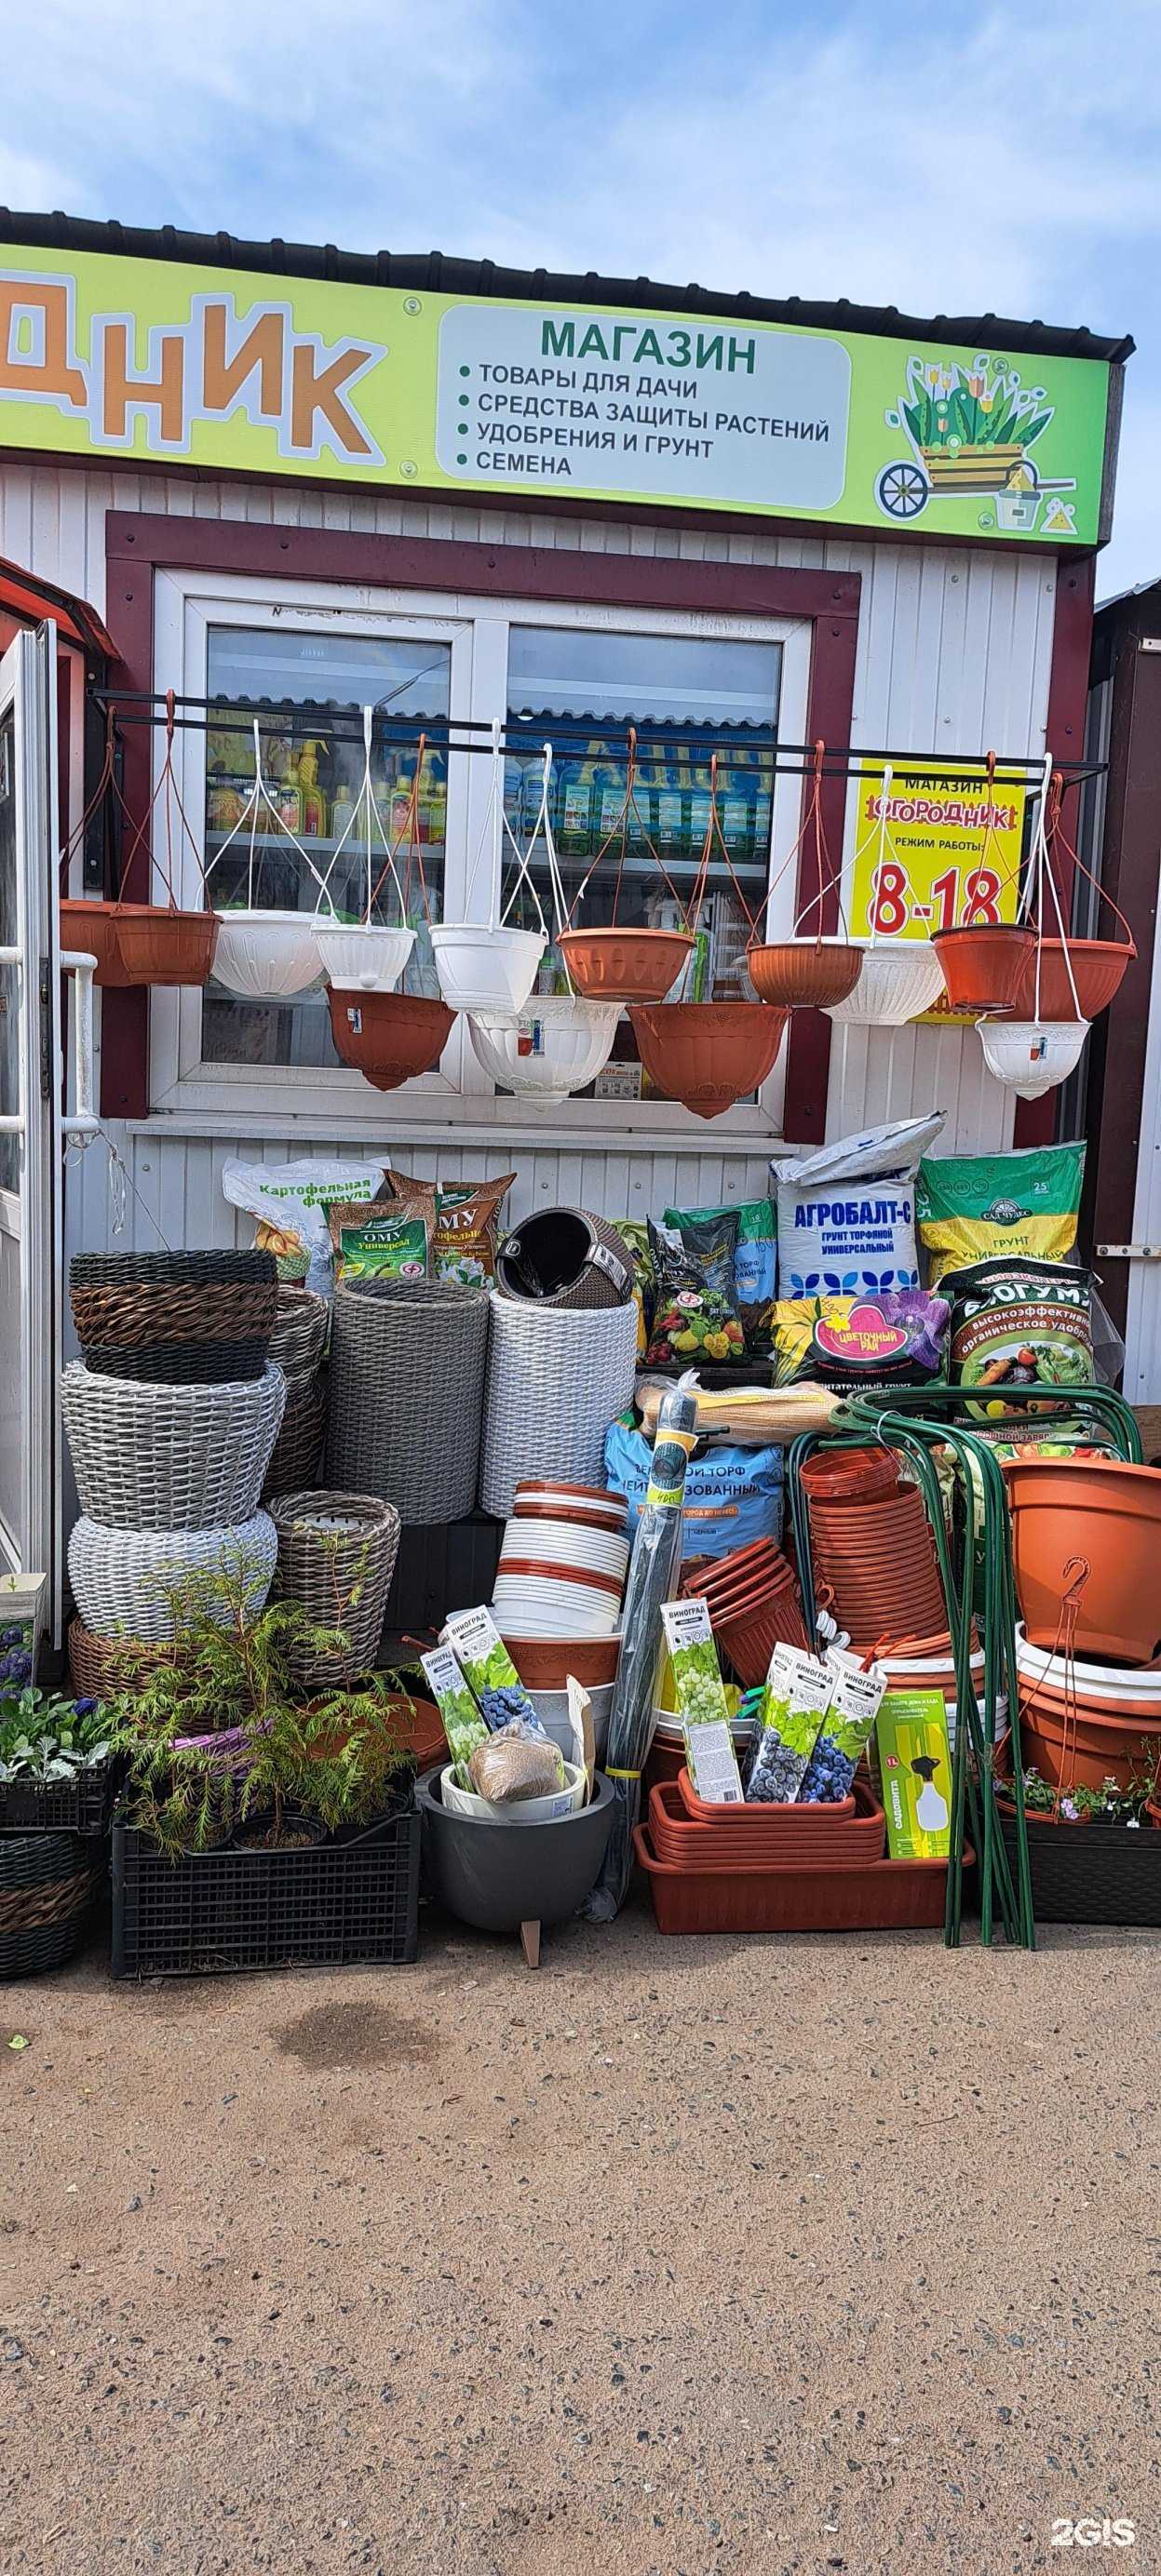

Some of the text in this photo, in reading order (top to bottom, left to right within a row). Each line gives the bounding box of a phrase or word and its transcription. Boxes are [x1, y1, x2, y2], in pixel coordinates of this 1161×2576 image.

[541, 320, 756, 374] МАГАЗИН
[479, 364, 697, 399] ТОВАРЫ ДЛЯ ДАЧИ
[478, 393, 830, 442] СРЕДСТВА ЗАЩИТЫ РАСТЕНИЙ
[478, 422, 713, 458] УДОБРЕНИЯ И ГРУНТ
[477, 451, 572, 476] СЕМЕНА
[905, 778, 982, 794] МАГАЗИН
[874, 798, 1009, 829] ОГОРОДНИК
[896, 837, 984, 852] РЕЖИМ РАБОТЫ:
[867, 861, 1002, 937] 8-18
[260, 1179, 371, 1198] Картофельная
[303, 1191, 371, 1208] формула
[438, 1209, 478, 1229] МУ
[794, 1201, 911, 1228] АГРОБАЛТ-С
[364, 1230, 402, 1242] ОМУ
[822, 1228, 893, 1241] ГРУНТ ТОРФЯНОЙ
[992, 1236, 1029, 1248] ГРУНТ
[822, 1241, 894, 1255] УНИВЕРСАЛЬНЫЙ
[839, 1331, 898, 1344] ЦВЕТОЧНЫЙ
[962, 1320, 1047, 1353] органическое
[822, 1382, 883, 1392] итательный
[709, 1466, 745, 1478] ТОРФ
[668, 1605, 705, 1618] ВИНОГРАД
[452, 1613, 487, 1635] ВИНОГРАД
[796, 1662, 833, 1684] ВИНОГРАД
[844, 1671, 882, 1693] ВИНОГРАД
